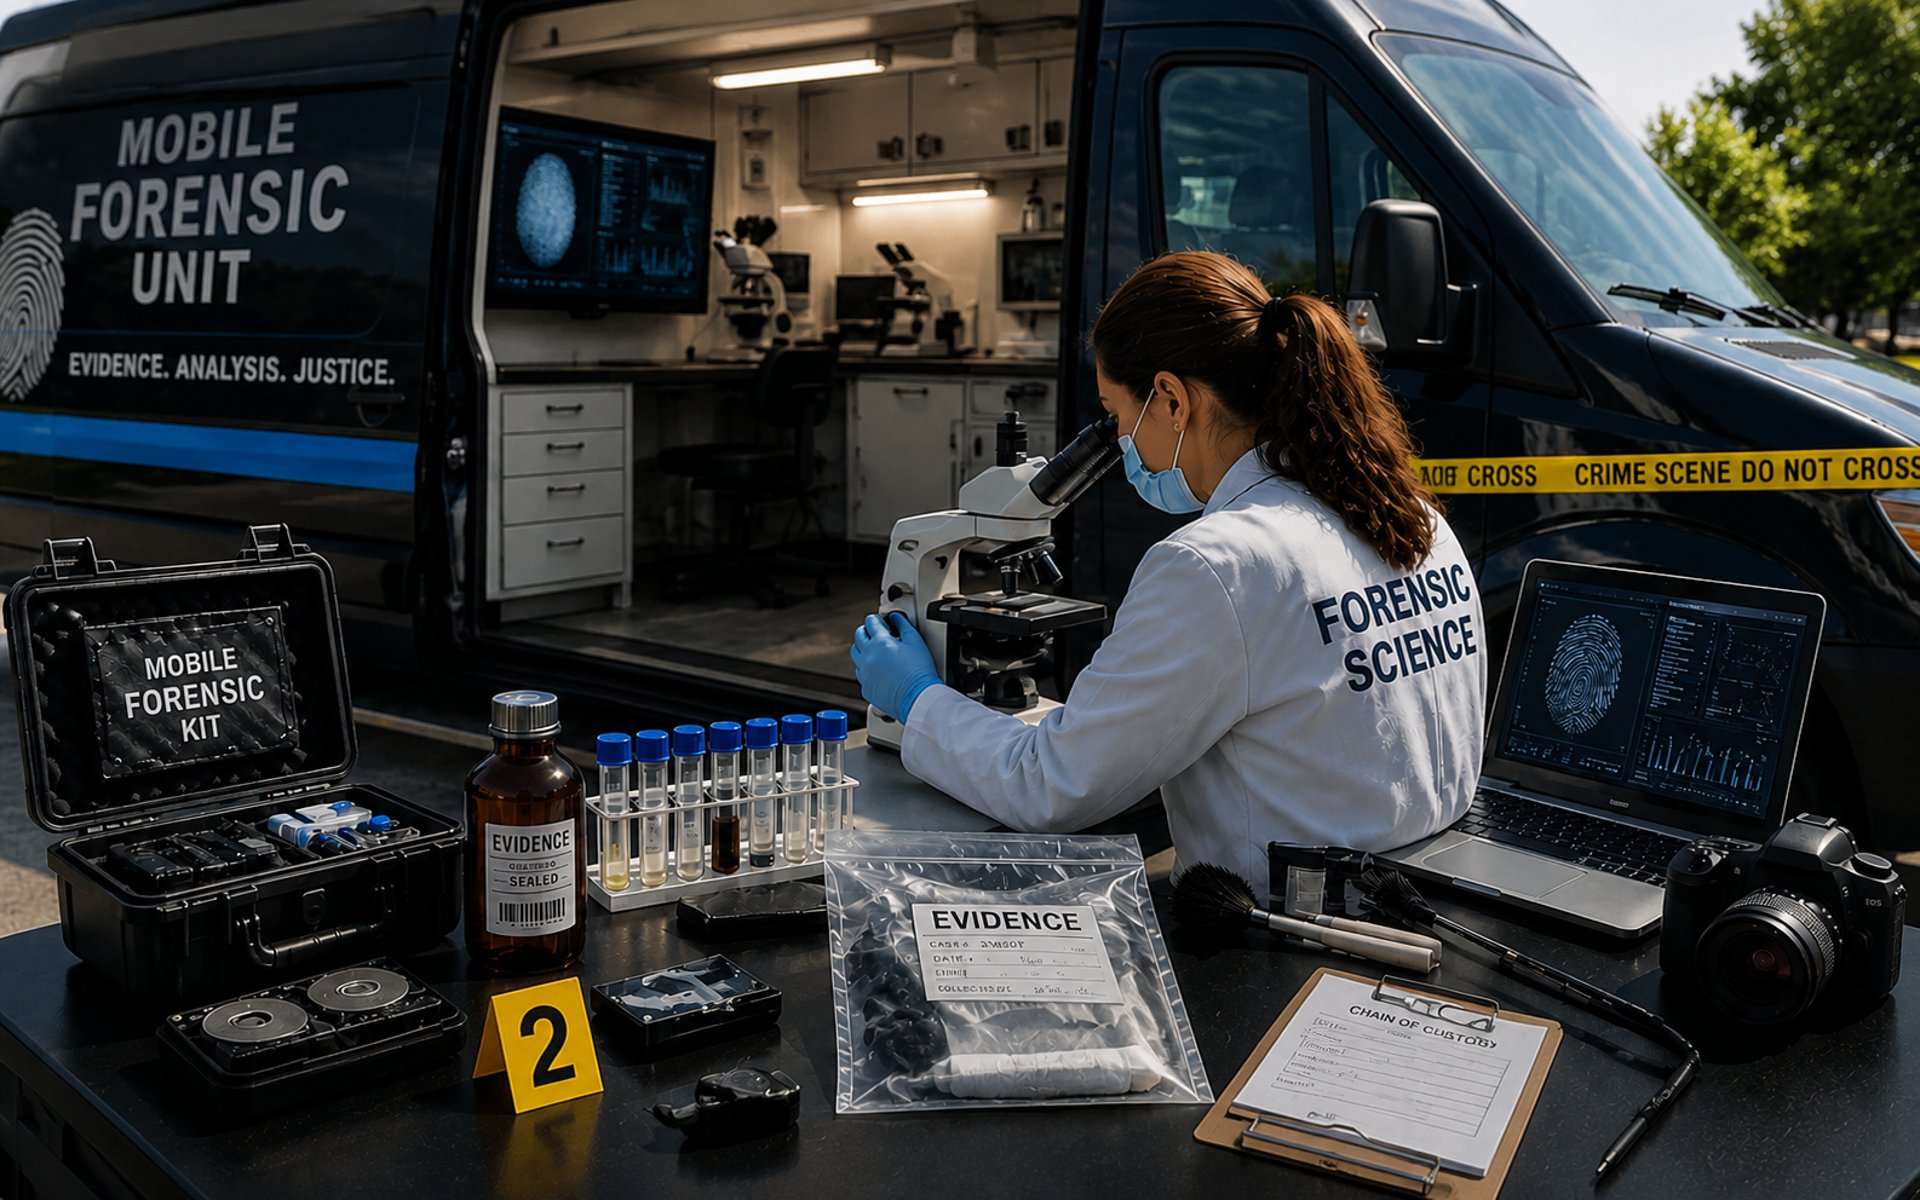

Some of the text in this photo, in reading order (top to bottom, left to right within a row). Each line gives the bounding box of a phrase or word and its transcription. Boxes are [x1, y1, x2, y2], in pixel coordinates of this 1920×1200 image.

[118, 102, 298, 166] MOBILE
[70, 165, 349, 242] FORENSIC
[132, 249, 251, 304] UNIT
[69, 352, 395, 385] EVIDENCE. ANALYSIS. JUSTICE.
[1467, 464, 1537, 487] CROSS
[1575, 456, 1920, 486] CRIME SCENE DO NOT CROSS
[1312, 564, 1470, 645] FORENSIC
[144, 647, 238, 680] MOBILE
[1344, 615, 1477, 692] SCIENCE
[124, 675, 265, 719] FORENSIC
[181, 714, 221, 742] KIT
[493, 830, 569, 853] EVIDENCE
[509, 873, 558, 887] SEALED
[932, 911, 1082, 931] EVIDENCE
[1350, 1005, 1396, 1023] CHAIN
[1399, 1018, 1420, 1029] OF
[520, 1005, 576, 1088] 2
